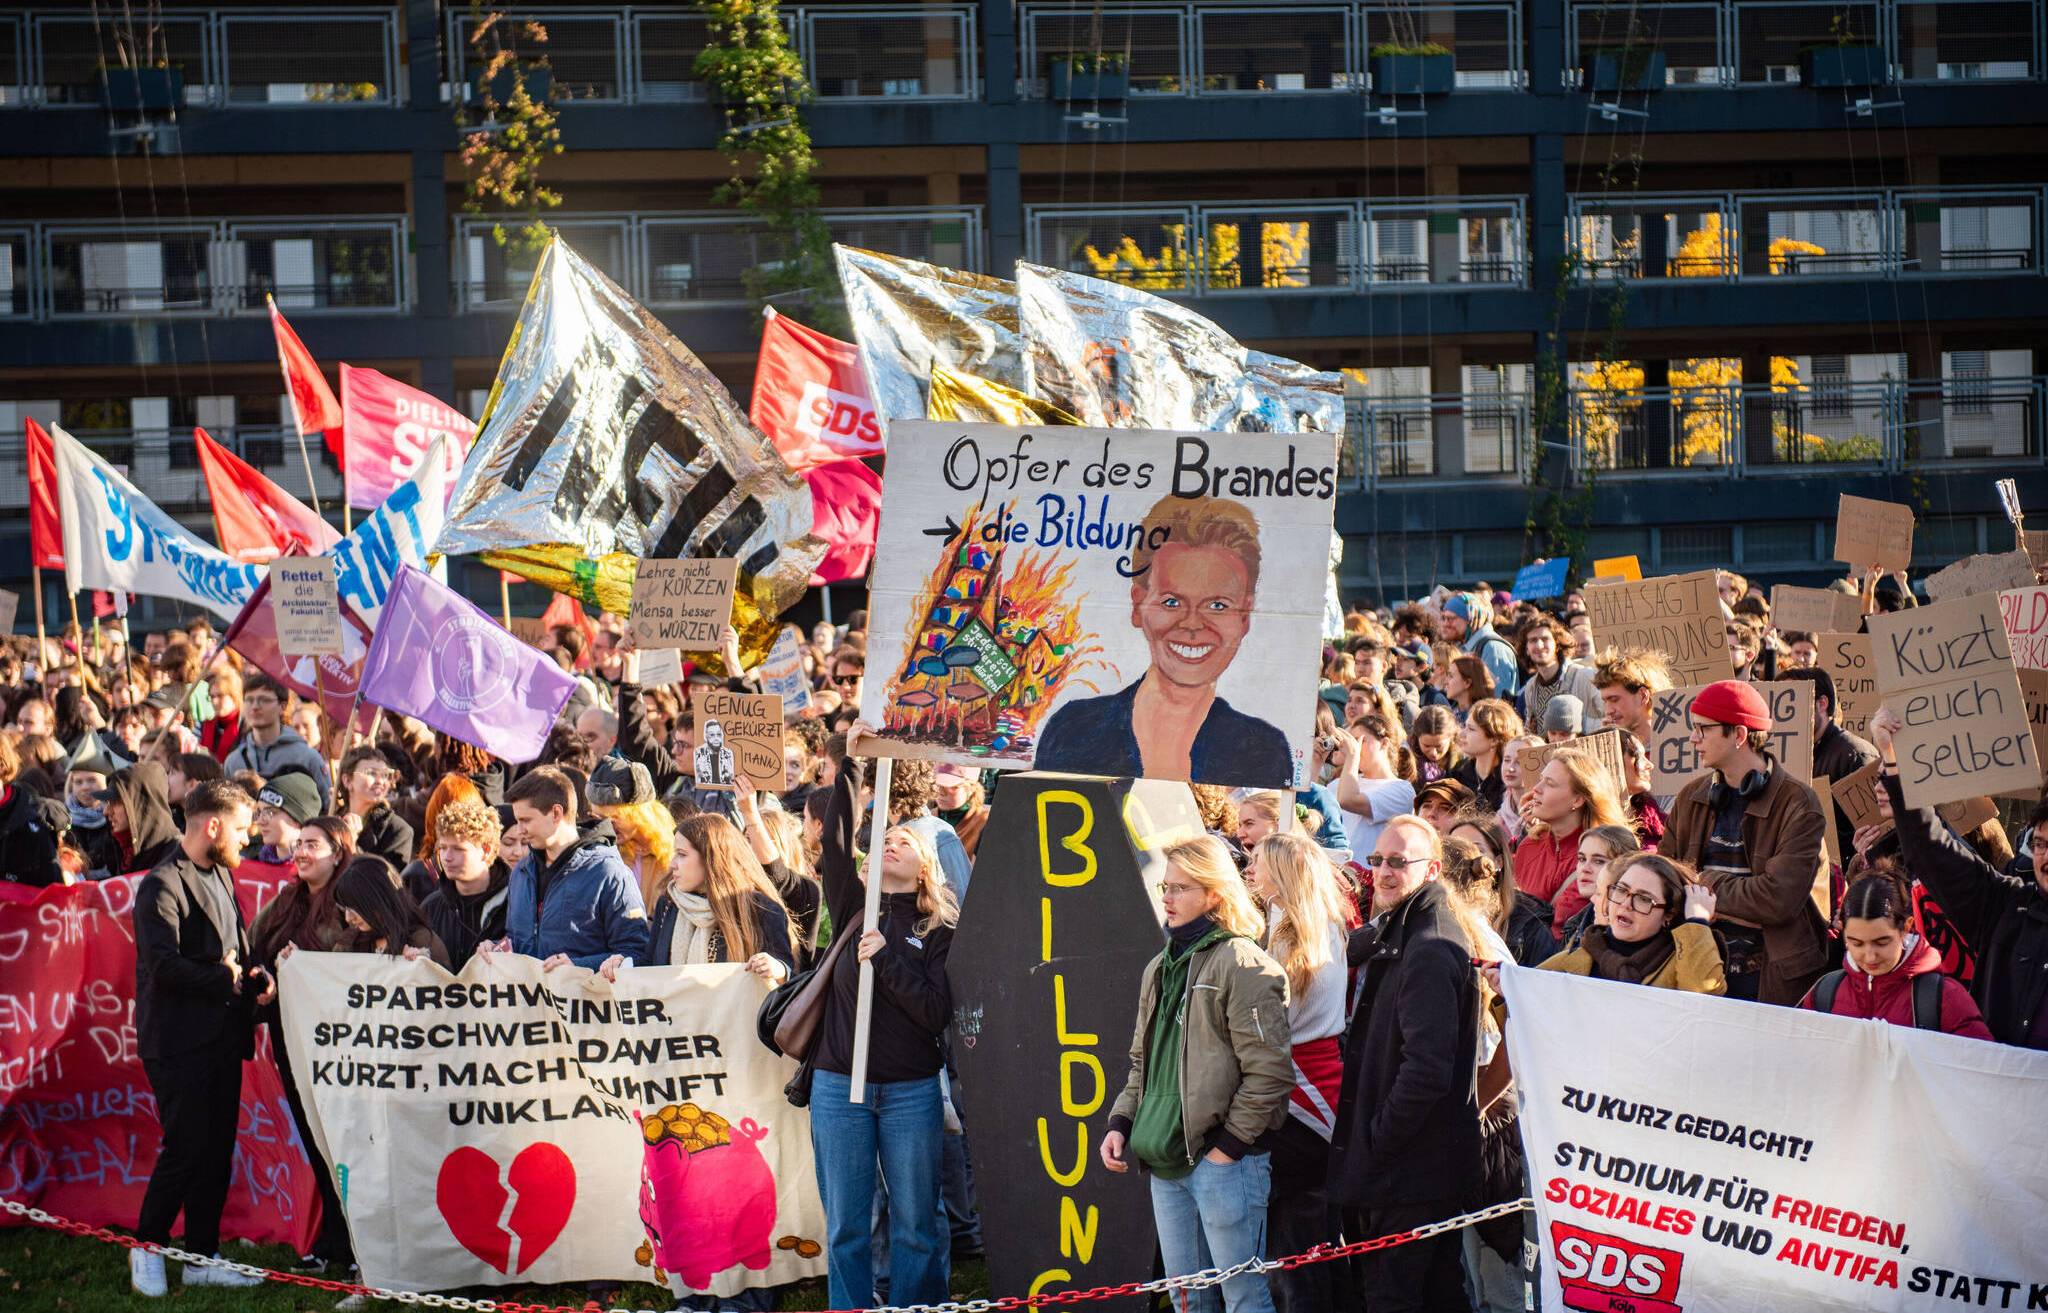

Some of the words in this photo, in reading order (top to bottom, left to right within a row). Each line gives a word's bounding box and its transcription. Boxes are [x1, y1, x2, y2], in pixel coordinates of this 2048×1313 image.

[810, 397, 881, 443] SDS
[390, 421, 474, 483] SD
[943, 433, 1071, 512] Opfer
[1082, 437, 1155, 489] des
[1170, 435, 1335, 500] Brandes
[981, 502, 1030, 545] die
[1034, 492, 1172, 578] Bildung
[281, 569, 324, 583] Rettet
[294, 585, 314, 597] die
[637, 561, 676, 579] Lehre
[683, 561, 711, 577] nicht
[663, 577, 728, 596] KÜRZEN
[630, 602, 673, 619] Mensa
[681, 602, 717, 618] besser
[659, 621, 721, 642] WÜRZEN
[1891, 613, 2012, 677] Kürzt
[704, 695, 766, 717] GENUG
[1905, 680, 2003, 727] euch
[723, 720, 782, 738] GEKÜRZT
[313, 1055, 429, 1093] KÜRZT,
[438, 1057, 586, 1089] MACHT
[1561, 1084, 1596, 1114] ZU
[1597, 1094, 1673, 1131] KURZ
[1674, 1112, 1813, 1162] GEDACHT!
[1554, 1141, 1704, 1199] STUDIUM
[1703, 1175, 1769, 1216] FÜR
[1771, 1194, 1910, 1255] FRIEDEN,
[1545, 1176, 1697, 1236] SOZIALES
[1702, 1214, 1774, 1256] UND
[1776, 1236, 1899, 1290] ANTIFA
[1907, 1265, 2020, 1310] STATT
[1557, 1236, 1666, 1295] SDS
